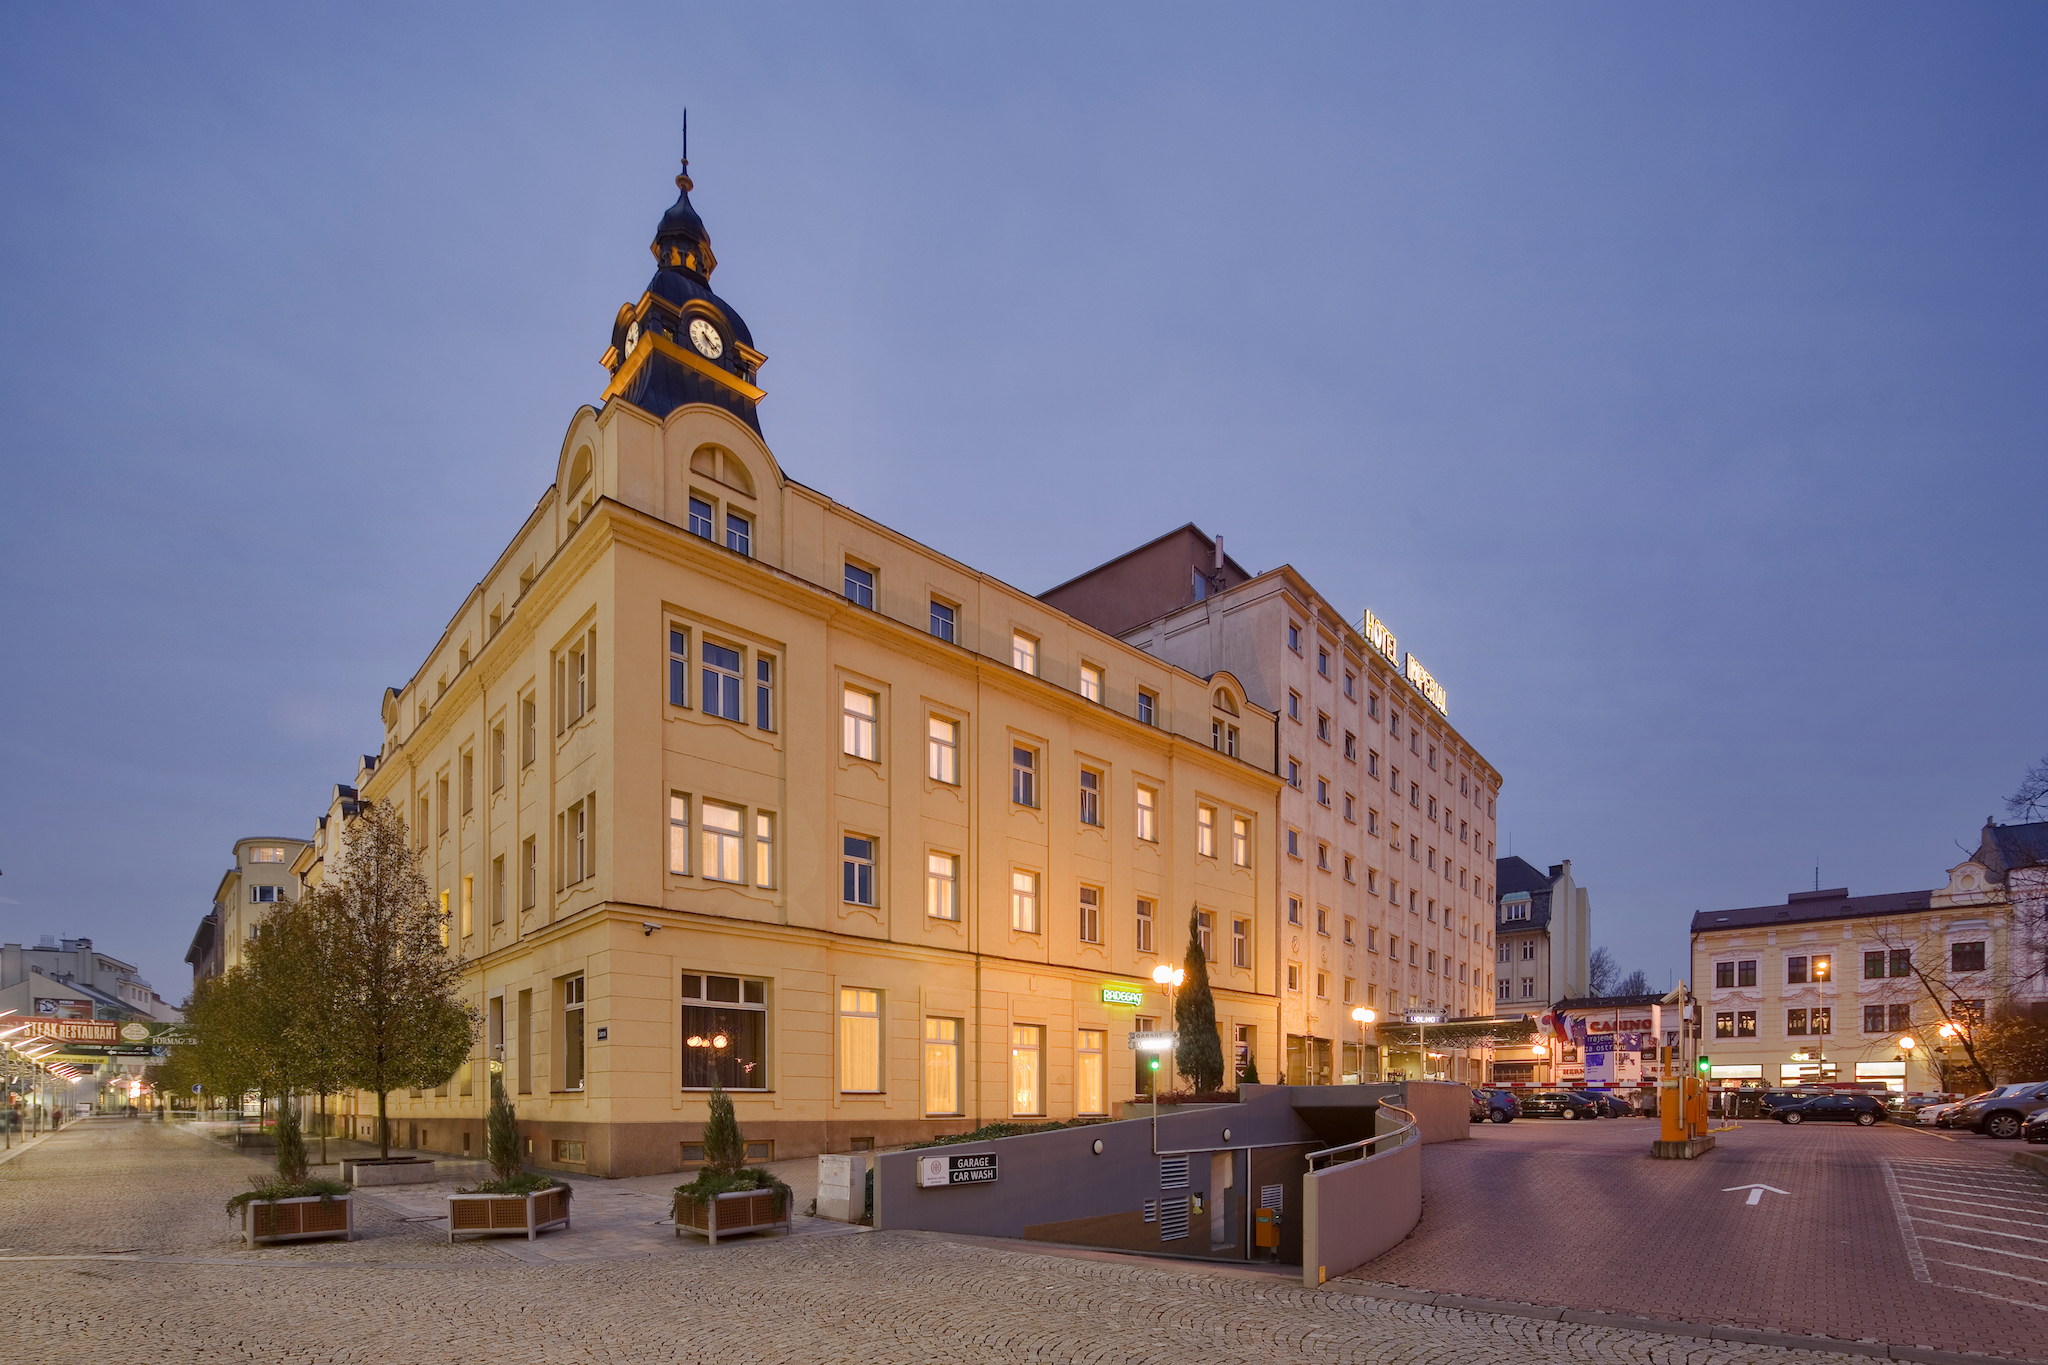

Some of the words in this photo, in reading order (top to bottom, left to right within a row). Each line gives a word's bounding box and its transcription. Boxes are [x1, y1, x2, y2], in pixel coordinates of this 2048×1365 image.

[1365, 609, 1399, 667] HOTEL
[1406, 652, 1447, 717] IMPERIAL
[24, 1021, 59, 1038] STEAK
[60, 1024, 118, 1040] RESTAURANT
[1590, 1019, 1652, 1032] CASINO
[957, 1157, 989, 1168] GARAGE
[953, 1171, 970, 1181] CAR
[970, 1170, 993, 1180] WASH
